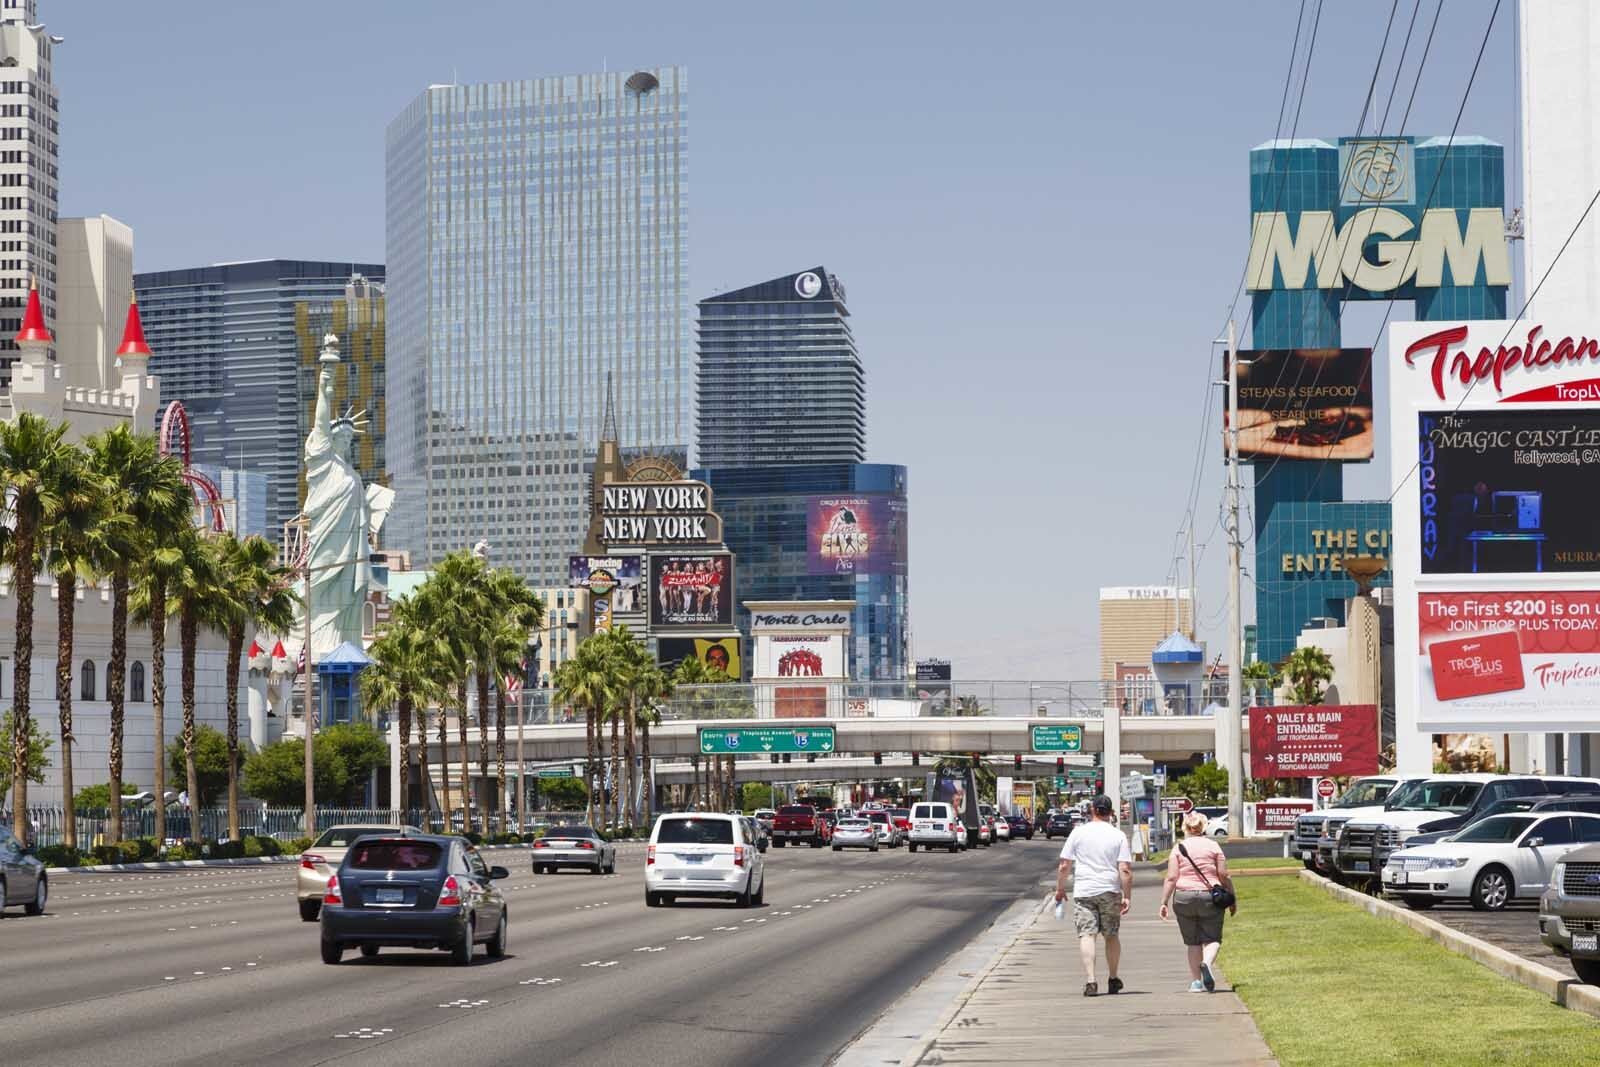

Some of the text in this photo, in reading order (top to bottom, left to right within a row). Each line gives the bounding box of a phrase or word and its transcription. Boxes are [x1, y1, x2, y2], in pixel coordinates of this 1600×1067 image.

[1246, 207, 1512, 292] MGM
[1405, 324, 1600, 401] Tropican
[1240, 386, 1358, 398] STEAKS & SEAFOOD
[1440, 415, 1463, 428] The
[1430, 425, 1600, 454] MAGIC CASTLE
[1514, 449, 1581, 467] Hollywood,
[603, 487, 706, 510] NEW YORK
[603, 516, 707, 539] NEW YORK
[1312, 528, 1392, 548] THE CI
[668, 574, 714, 585] ZUMANITY
[1128, 589, 1169, 597] TRUMP
[1426, 600, 1458, 616] The
[1463, 600, 1501, 616] First
[1504, 599, 1546, 615] $200
[1551, 600, 1563, 615] is
[1568, 603, 1590, 615] on
[754, 613, 847, 626] Monte Carlo
[1448, 618, 1598, 632] JOIN TROP PLUS TODAY.
[1448, 656, 1482, 671] TROP
[1276, 712, 1342, 723] VALET & MAIN
[1277, 724, 1327, 734] ENTRANCE
[727, 736, 738, 746] 15
[797, 736, 808, 745] 15
[1277, 752, 1343, 763] SELF PARKING
